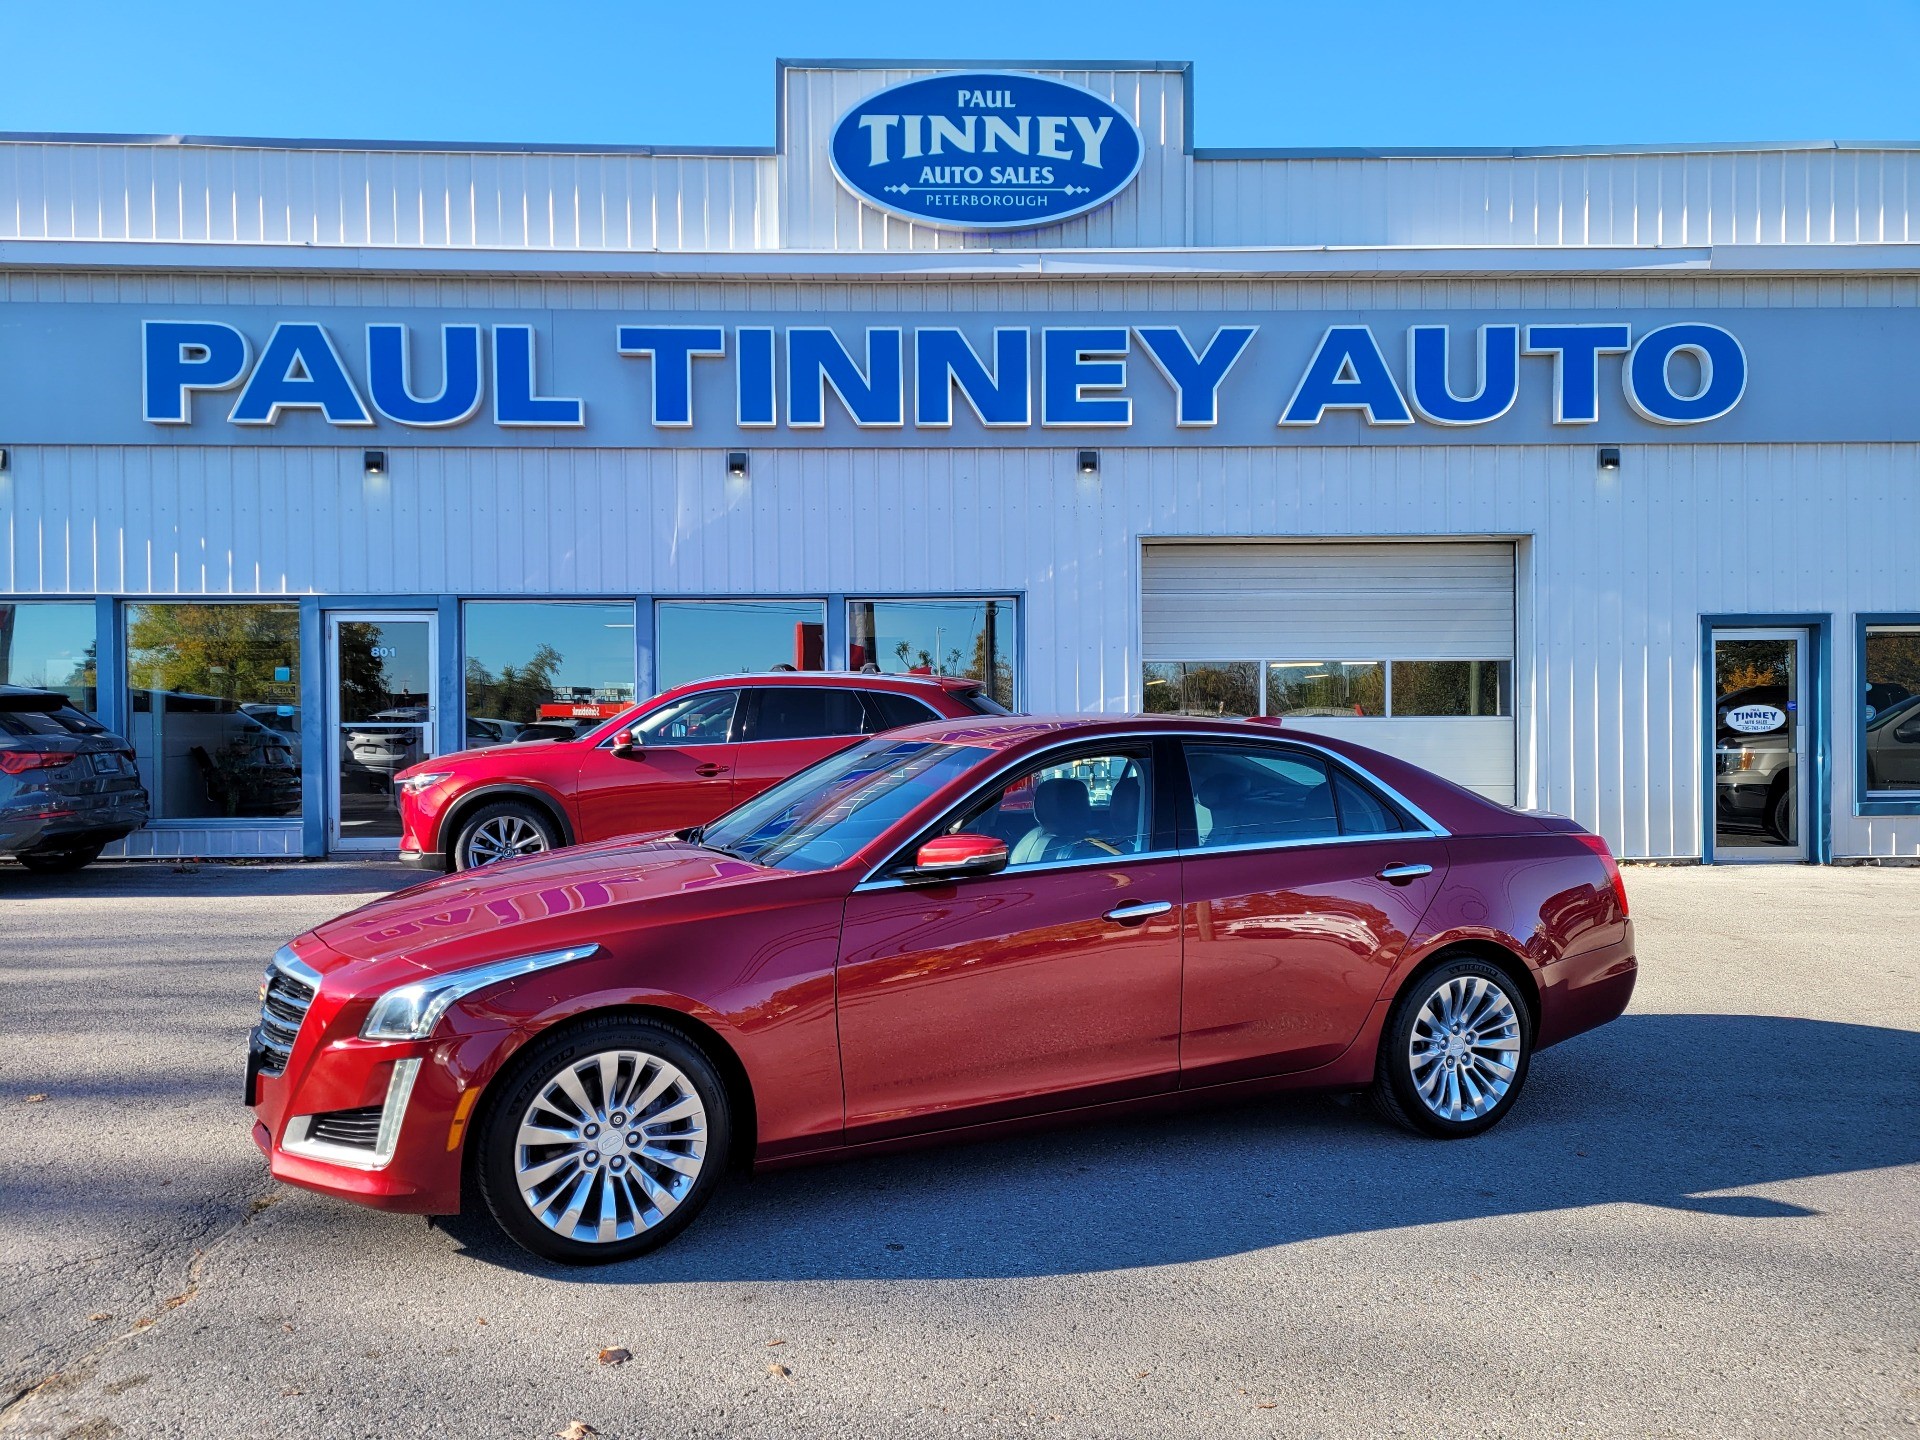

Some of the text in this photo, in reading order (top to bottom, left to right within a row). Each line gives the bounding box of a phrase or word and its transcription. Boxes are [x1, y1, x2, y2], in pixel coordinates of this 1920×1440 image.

[957, 89, 1016, 108] PAUL
[858, 114, 1114, 169] TINNEY
[919, 166, 1055, 184] AUTO SALES
[926, 195, 1048, 206] PETERBOROUGH
[141, 319, 1749, 428] PAUL TINNEY AUTO
[370, 647, 396, 657] 801
[1734, 712, 1777, 722] TINNEY
[1459, 964, 1497, 976] MICHELIN
[519, 1048, 572, 1100] MICHELIN
